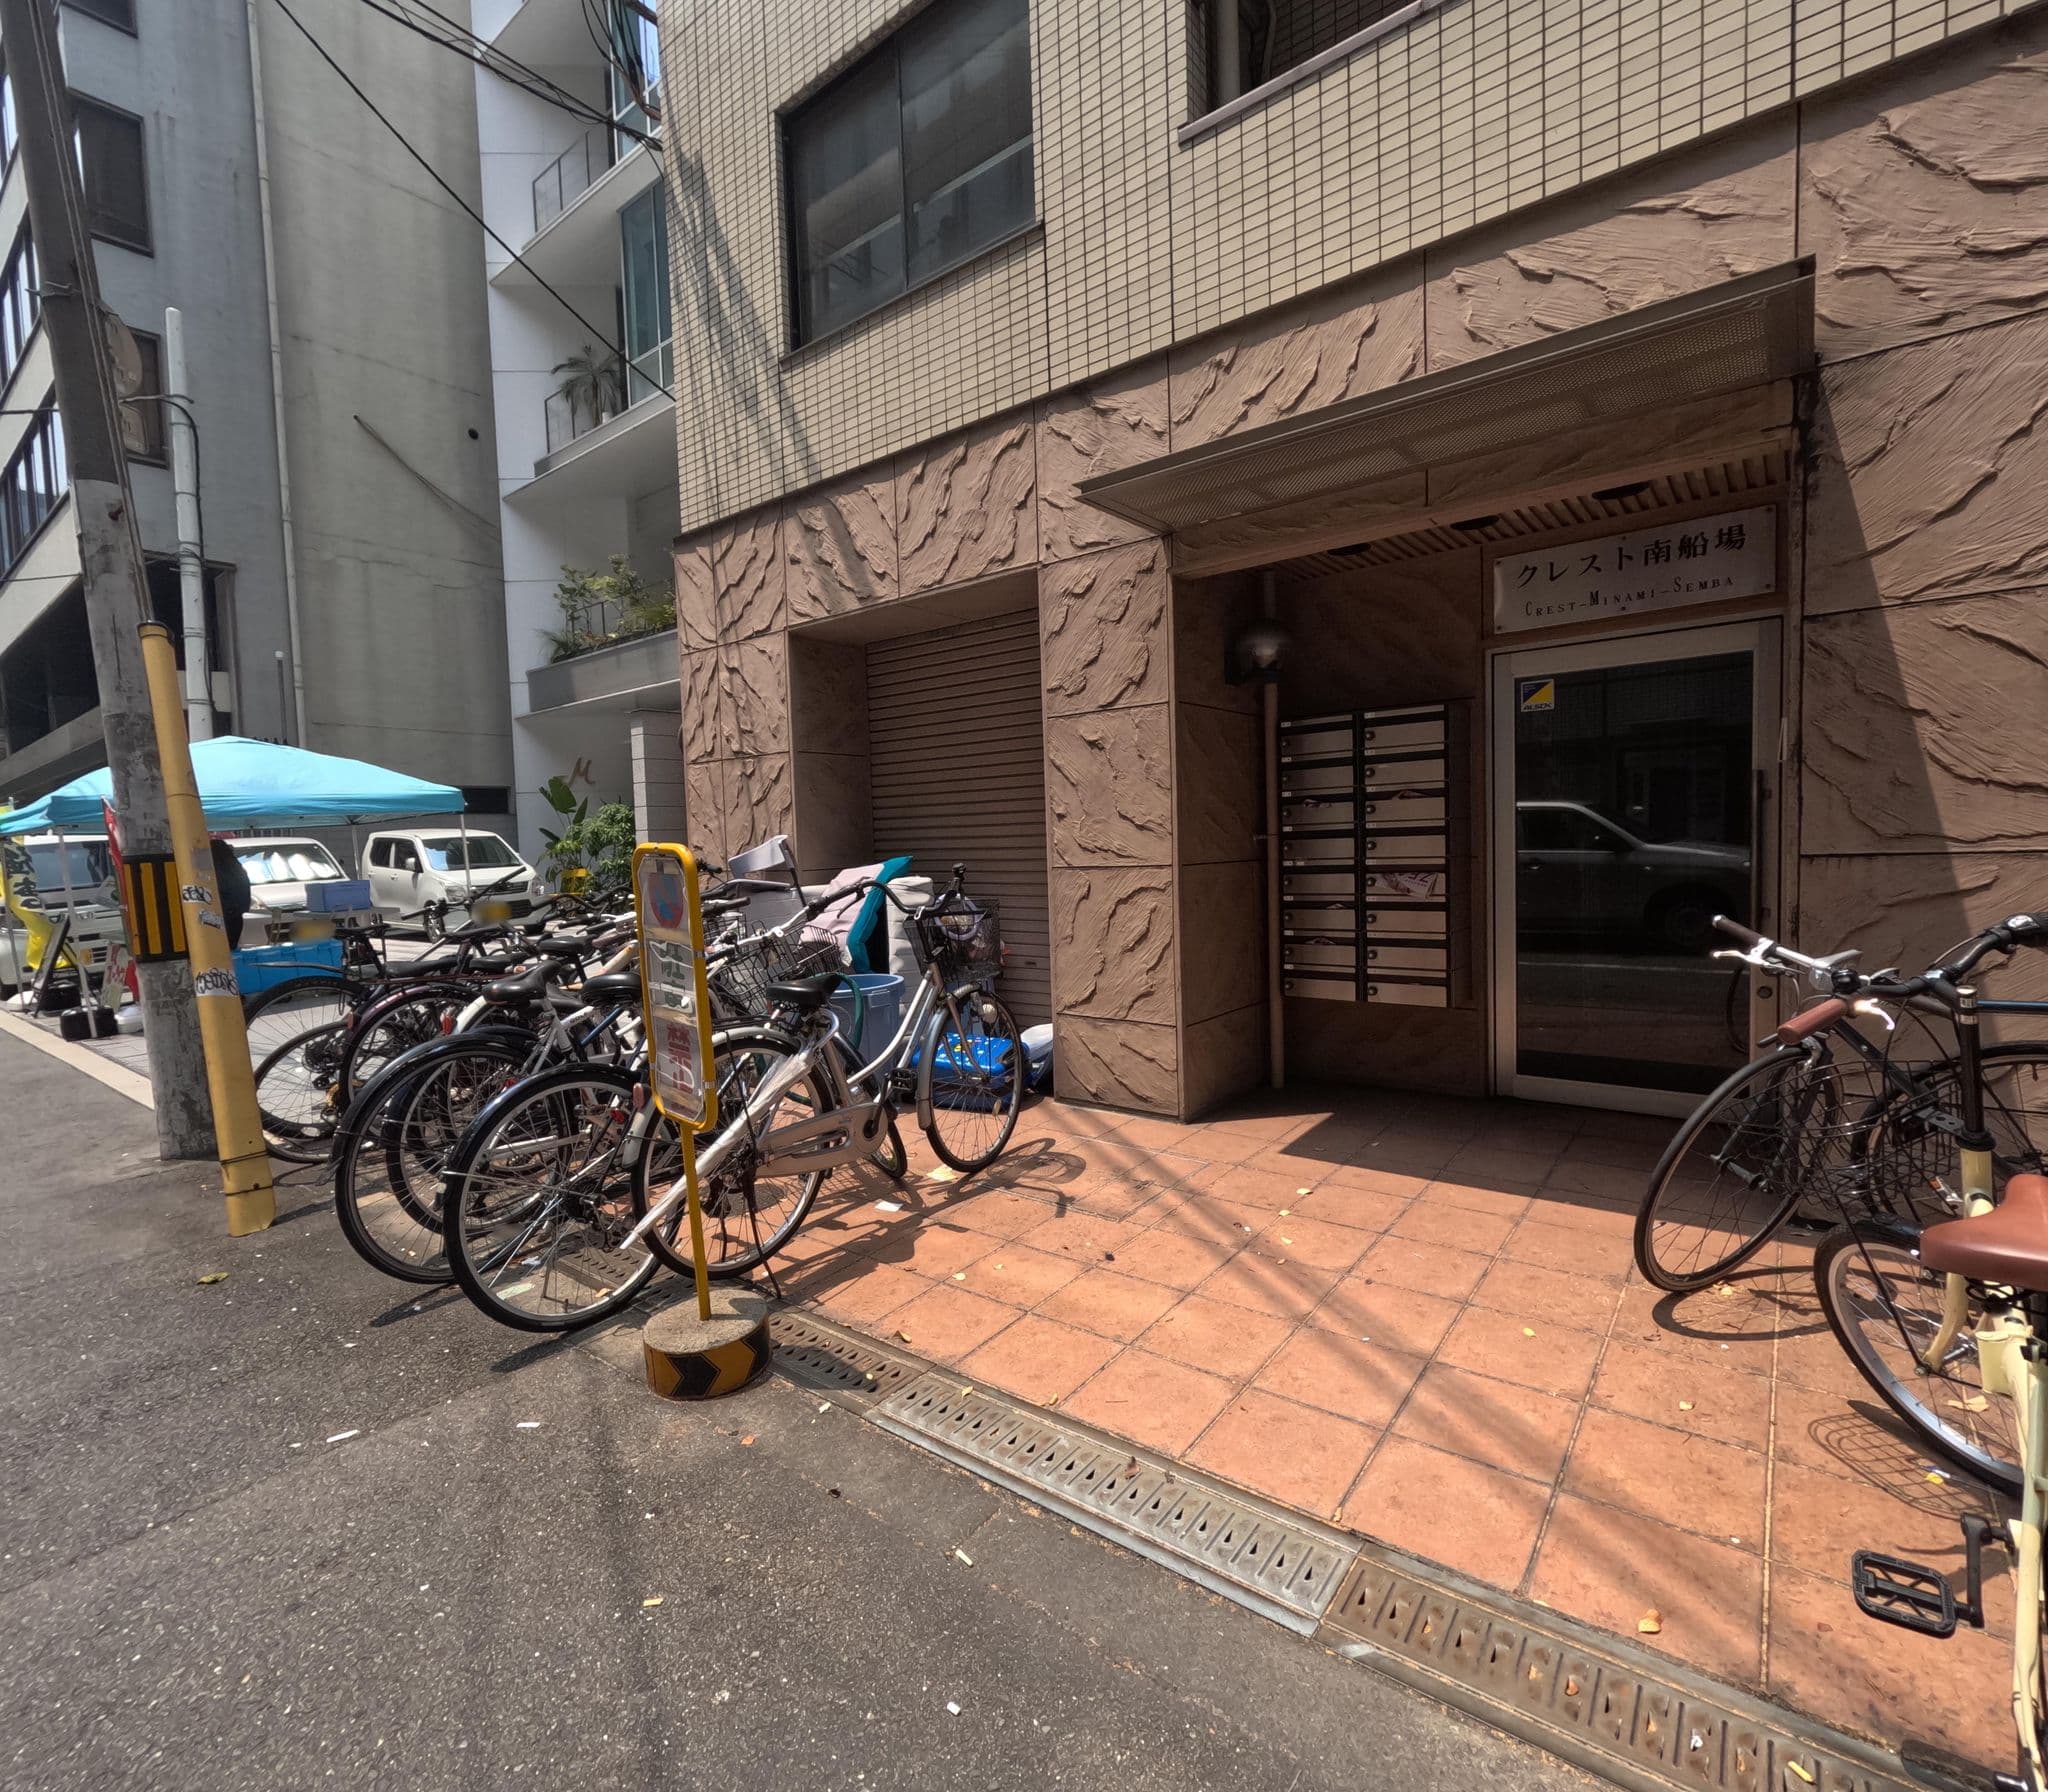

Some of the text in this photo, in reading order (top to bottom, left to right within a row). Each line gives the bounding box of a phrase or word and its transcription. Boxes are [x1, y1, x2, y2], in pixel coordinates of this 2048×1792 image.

[1517, 523, 1746, 588] クレスト南船場
